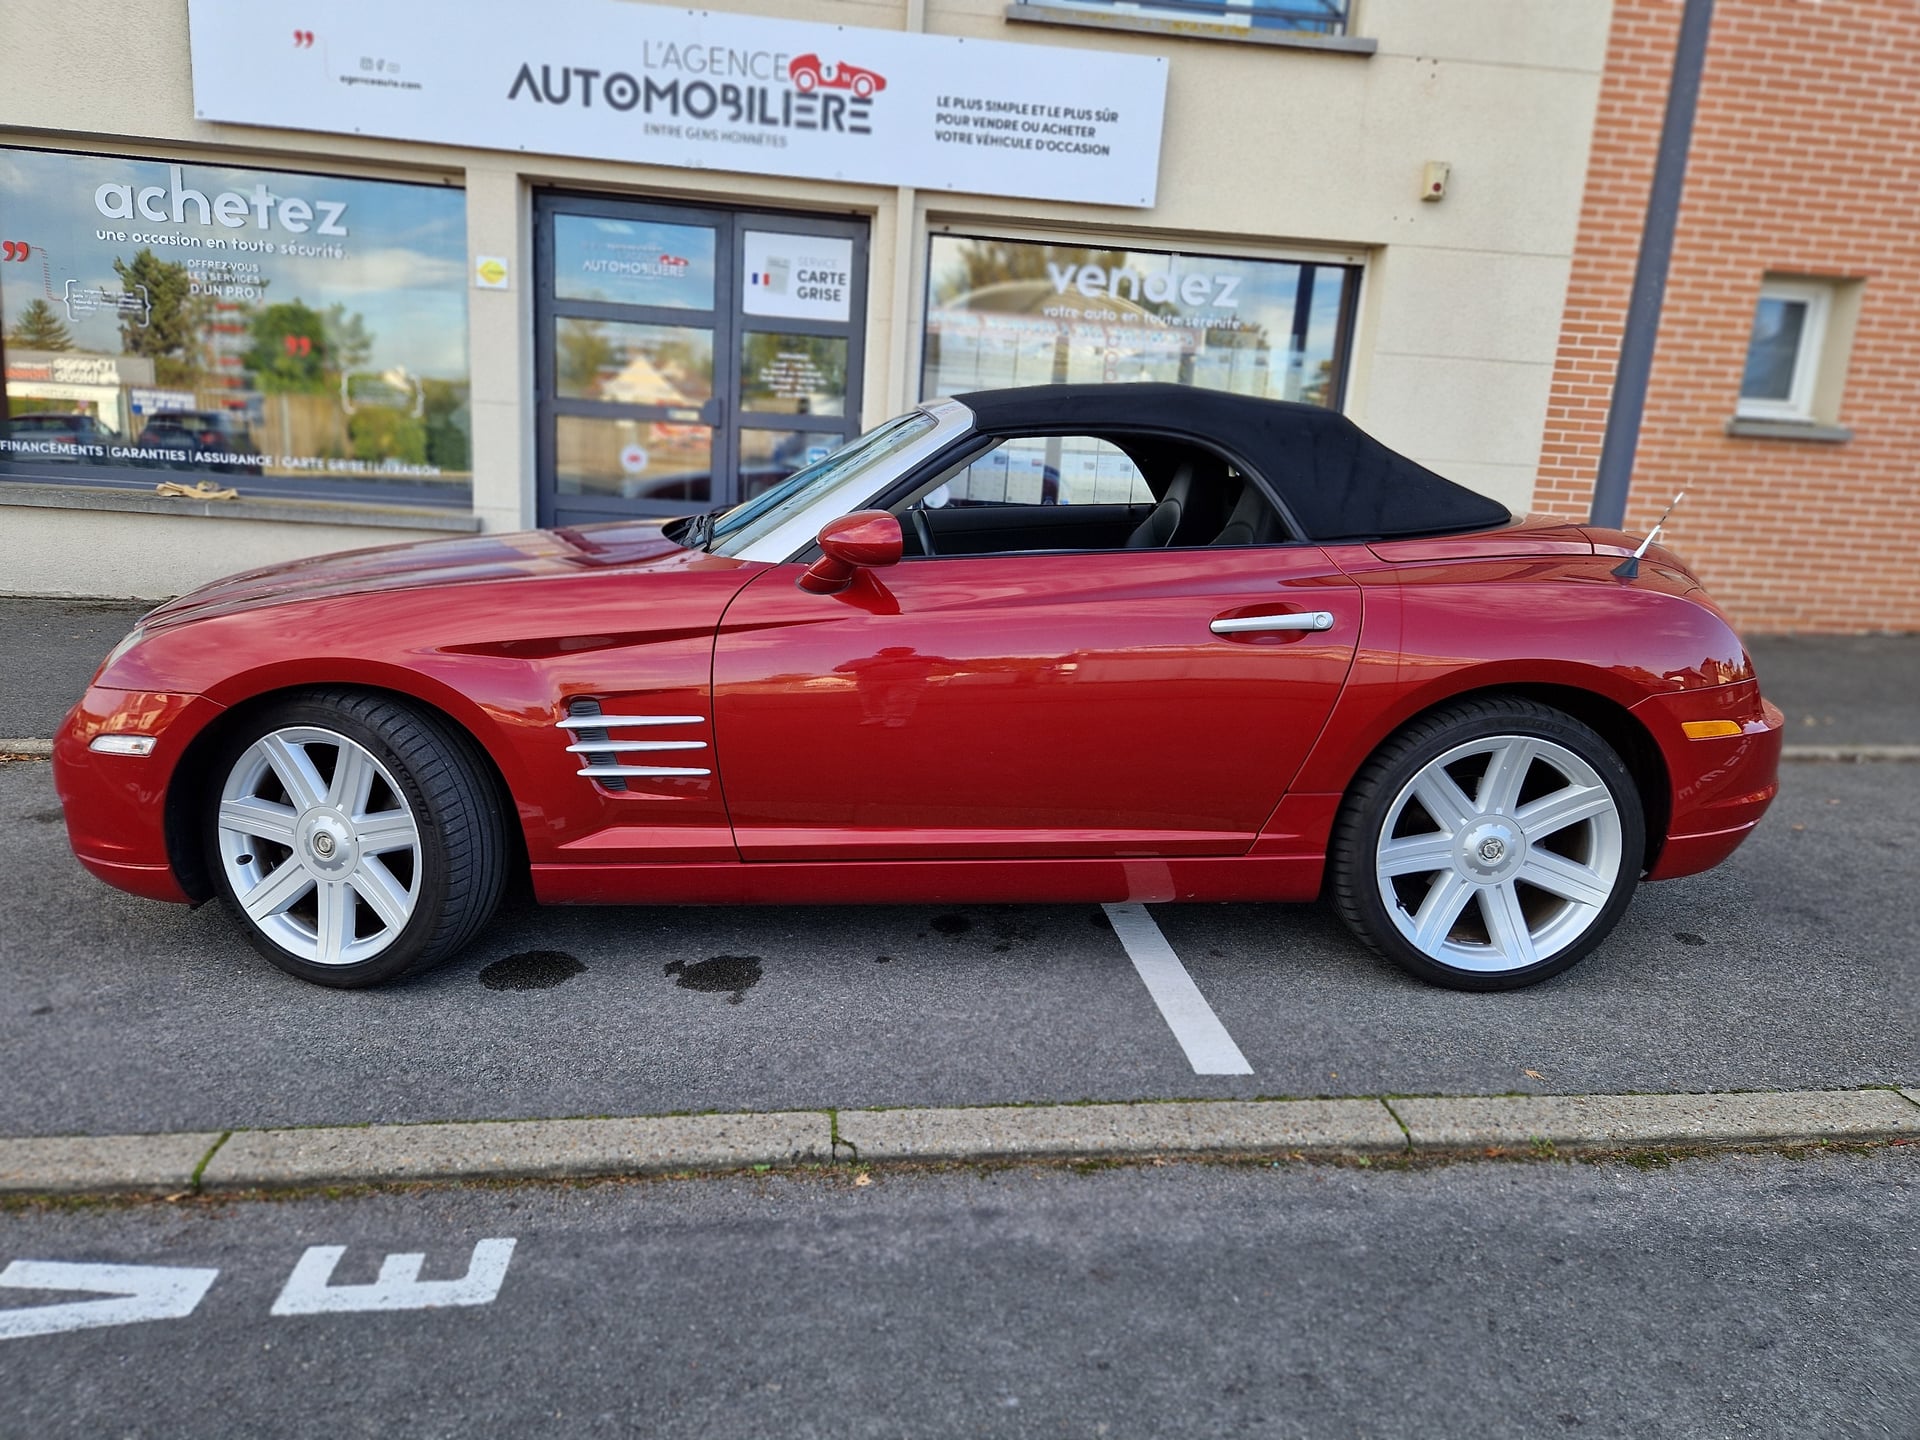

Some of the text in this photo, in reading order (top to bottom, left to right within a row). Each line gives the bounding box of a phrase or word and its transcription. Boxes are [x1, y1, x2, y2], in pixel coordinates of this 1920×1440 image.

[643, 40, 789, 83] L'AGENCE
[936, 96, 1119, 123] LE PLUS SIMPLE ET LE PLUS SÛR
[644, 123, 682, 138] ENTRE
[685, 126, 719, 142] GENS
[935, 113, 1096, 138] POUR VENDRE OU ACHETER
[934, 130, 1110, 156] VOTRE VÉHICULE D'OCCASION
[94, 165, 348, 237] achetez
[96, 229, 127, 242] une
[132, 231, 201, 248] occasion
[206, 237, 226, 250] en
[231, 237, 275, 254] toute
[187, 258, 260, 273] OFFREZ-VOUS
[187, 271, 261, 285] LES SERVICES
[797, 269, 847, 286] CARTE
[190, 283, 222, 296] D'UN
[226, 285, 255, 299] PRO
[1048, 253, 1242, 308] vendez
[796, 286, 842, 302] GRISE
[1043, 306, 1079, 319] votre
[1083, 308, 1117, 322] auto
[1121, 311, 1139, 322] en
[1143, 312, 1181, 327] toute
[0, 440, 103, 457] FINANCEMENTS
[111, 446, 186, 461] GARANTIES
[195, 450, 273, 467] ASSURANCE
[281, 455, 325, 471] CARTE
